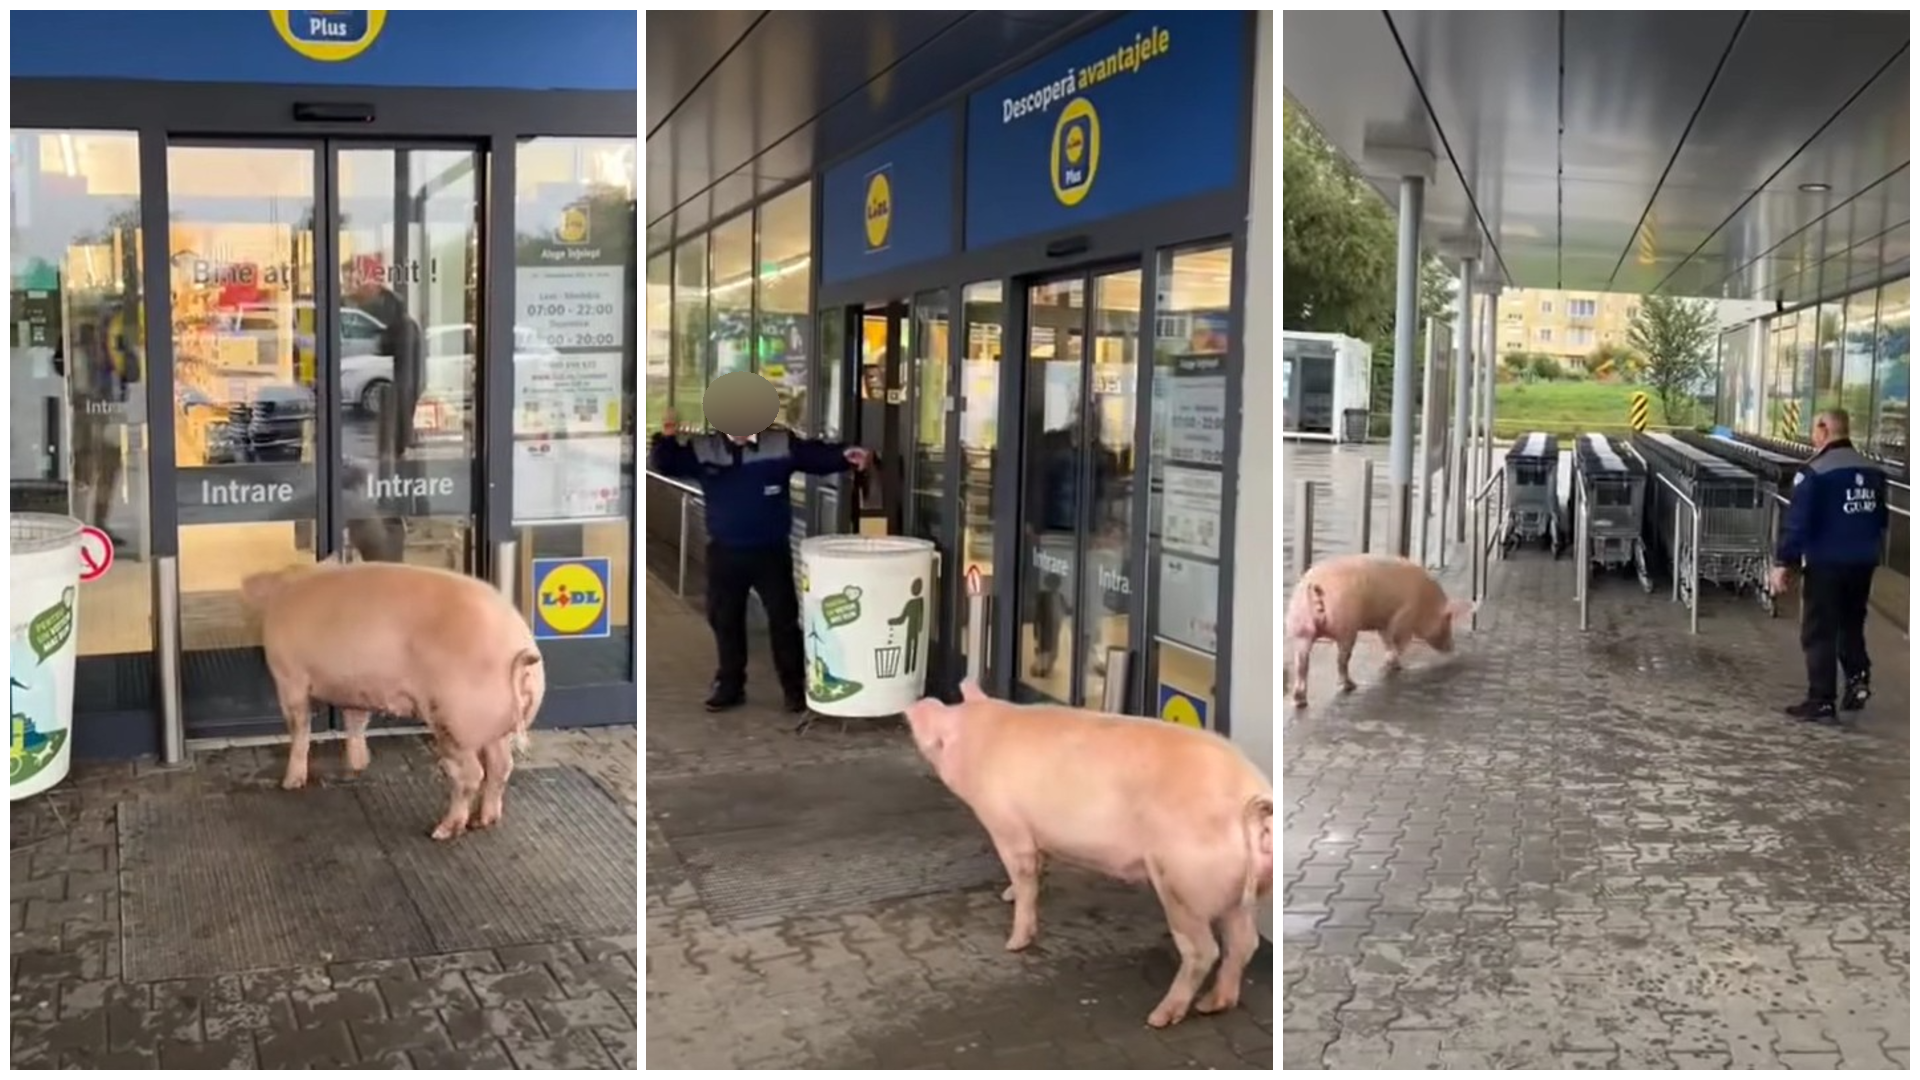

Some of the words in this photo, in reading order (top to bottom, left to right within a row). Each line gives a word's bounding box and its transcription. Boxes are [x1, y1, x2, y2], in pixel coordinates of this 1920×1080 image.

[309, 17, 347, 36] Plus
[1003, 68, 1076, 123] Descoperă
[1078, 26, 1170, 89] avantajele
[1066, 169, 1082, 186] Plus
[194, 260, 253, 284] Bine
[527, 303, 565, 317] 07:00
[576, 303, 614, 316] 22:00
[576, 333, 614, 346] 20:00
[202, 479, 294, 504] Intrare
[367, 473, 454, 498] Intrare
